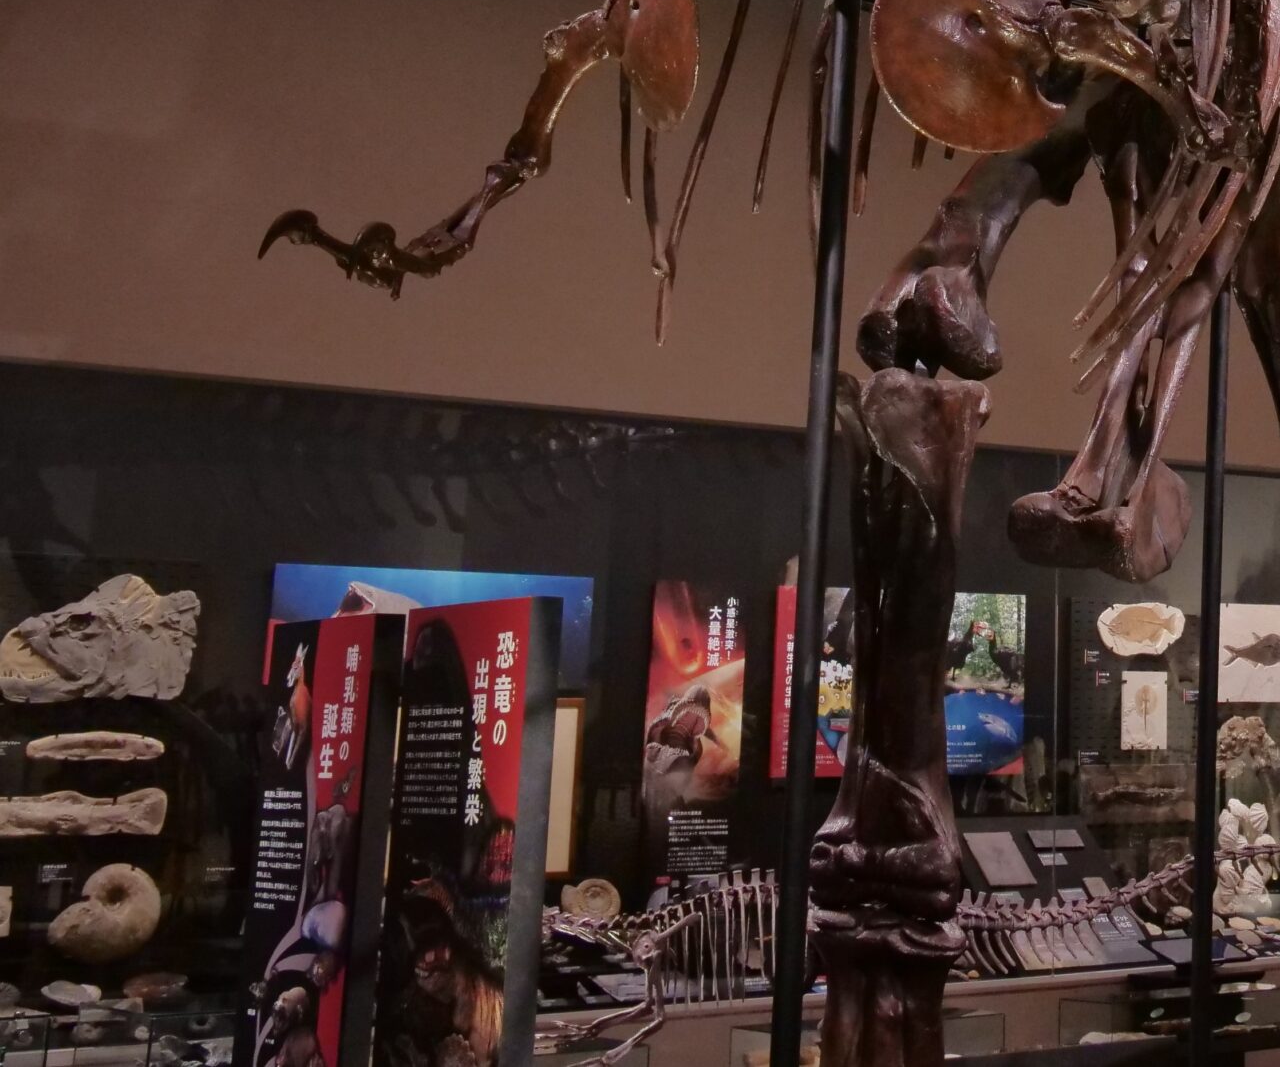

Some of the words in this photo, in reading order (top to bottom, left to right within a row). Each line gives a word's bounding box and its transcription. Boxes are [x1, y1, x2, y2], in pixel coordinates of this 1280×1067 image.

[493, 631, 514, 745] 恐竜の
[707, 606, 722, 666] 大量絶滅
[318, 703, 339, 779] 誕生
[340, 645, 360, 761] 哺乳類の
[464, 659, 489, 826] 出現と繁栄
